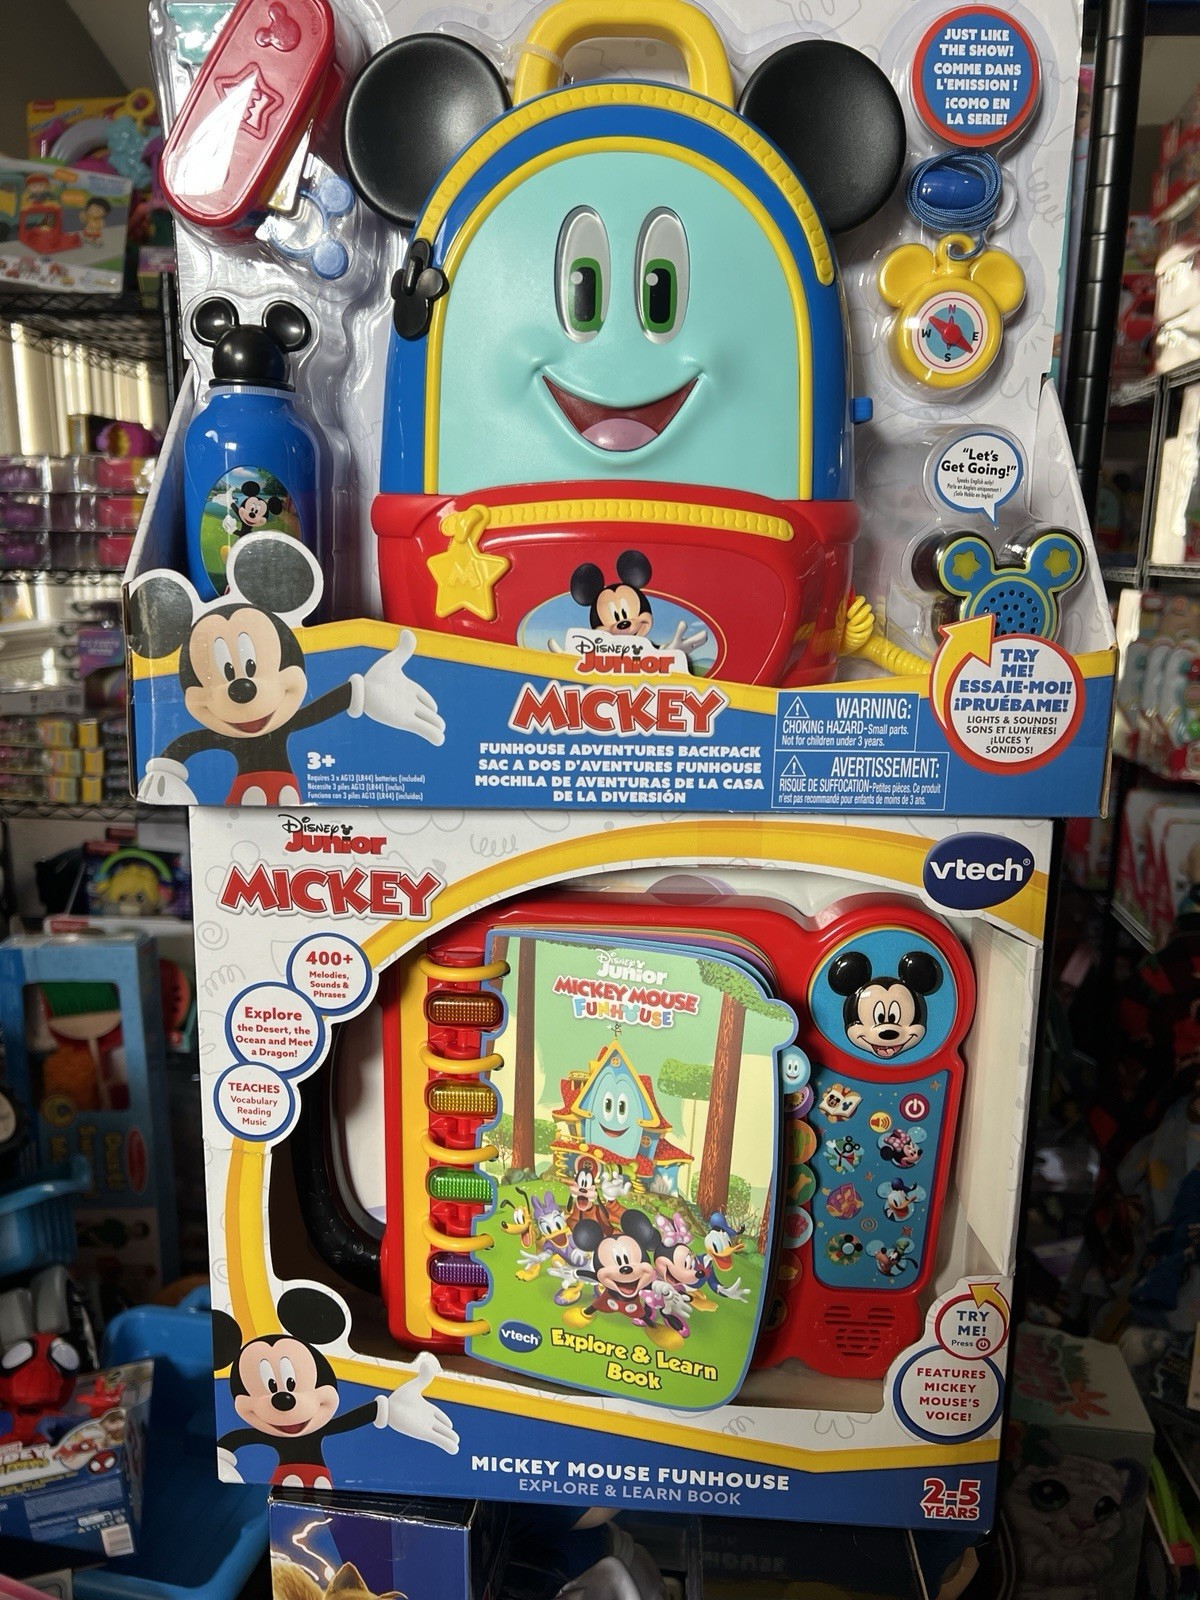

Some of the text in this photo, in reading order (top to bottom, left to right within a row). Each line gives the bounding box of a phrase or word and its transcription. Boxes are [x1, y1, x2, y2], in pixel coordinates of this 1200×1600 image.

[944, 28, 1010, 41] JUST LIKE
[939, 43, 1014, 57] THE SHOW!
[933, 62, 1022, 76] COMME DANS
[936, 78, 1010, 91] L'EMISSION
[945, 97, 1011, 110] ¡COMO EN
[946, 113, 1008, 126] LA SERIE!
[948, 304, 957, 314] N
[921, 328, 932, 338] W
[972, 331, 979, 341] E
[944, 353, 952, 362] S
[941, 460, 965, 473] Get
[571, 635, 631, 658] Disney
[1000, 648, 1040, 663] TRY
[577, 653, 675, 674] Junior
[1001, 664, 1035, 678] ME!
[959, 679, 1073, 695] ESSAIE-MOI!
[511, 683, 727, 733] MICKEY
[835, 697, 912, 720] WARNING:
[953, 695, 1070, 713] ¡PRUÉBAME!
[967, 715, 1058, 725] LIGHTS & SOUNDS!
[782, 719, 824, 735] CHOKING
[889, 724, 909, 738] parts.
[966, 725, 1057, 735] SONS ET LUMIÈRES!
[781, 735, 885, 749] Not for children under 3 years.
[990, 736, 1031, 745] ¡LUCES Y
[479, 742, 762, 758] FUNHOUSE ADVENTURES BACKPACK
[985, 746, 1034, 755] SONIDOS!
[306, 751, 336, 770] 3+
[478, 759, 762, 774] SAC A DOS D'AVENTURES FUNHOUSE
[830, 756, 940, 779] AVERTISSEMENT:
[307, 773, 330, 782] Requires
[330, 773, 335, 782] 3
[340, 774, 354, 782] AG13
[355, 774, 374, 783] (LR44)
[374, 774, 398, 783] batteries
[398, 774, 426, 784] (included)
[475, 775, 765, 790] MOCHILA DE AVENTURAS DE LA CASA
[332, 782, 337, 790] 3
[351, 783, 365, 791] AG13
[366, 783, 384, 792] (LR44)
[385, 783, 405, 792] (inclus)
[779, 778, 807, 793] RISQUE
[807, 778, 819, 792] DE
[891, 782, 912, 796] pièces.
[912, 782, 920, 794] Ce
[921, 783, 942, 796] produit
[307, 791, 331, 799] Funciona
[342, 791, 347, 799] 3
[361, 792, 376, 800] AG13
[376, 792, 395, 801] (LR44)
[553, 789, 686, 804] DE LA DIVERSIÓN
[792, 795, 804, 806] pas
[803, 793, 840, 804] recommandé
[840, 795, 854, 806] pour
[854, 793, 875, 805] enfants
[875, 794, 883, 805] de
[883, 795, 900, 805] moins
[901, 794, 909, 805] de
[909, 794, 914, 805] 3
[914, 796, 926, 805] ans.
[277, 813, 340, 840] Disney
[284, 830, 387, 855] Junior
[219, 862, 442, 917] MICKEY
[305, 951, 353, 966] 400+
[309, 970, 350, 980] Melodies,
[596, 961, 668, 985] Junior
[309, 980, 349, 989] Sounds &
[313, 990, 347, 999] Phrases
[553, 975, 700, 1015] MICKEY MOUSE
[244, 1006, 303, 1022] Explore
[237, 1023, 311, 1036] the Desert, the
[235, 1035, 314, 1047] Ocean and Meet
[259, 1048, 298, 1059] Dragon!
[228, 1082, 280, 1094] TEACHES
[230, 1095, 278, 1107] Vocabulary
[237, 1106, 272, 1117] Reading
[242, 1117, 267, 1126] Music
[956, 1310, 990, 1322] TRY
[957, 1325, 987, 1337] ME!
[951, 1339, 974, 1347] Press
[550, 1328, 718, 1382] Explore & Learn
[606, 1361, 662, 1390] Book
[916, 1367, 986, 1379] FEATURES
[924, 1382, 977, 1393] MICKEY
[925, 1410, 972, 1422] VOICE!
[471, 1455, 790, 1491] MICKEY MOUSE FUNHOUSE
[519, 1478, 741, 1506] EXPLORE & LEARN BOOK
[921, 1478, 981, 1506] 2-5
[922, 1504, 980, 1521] YEARS
